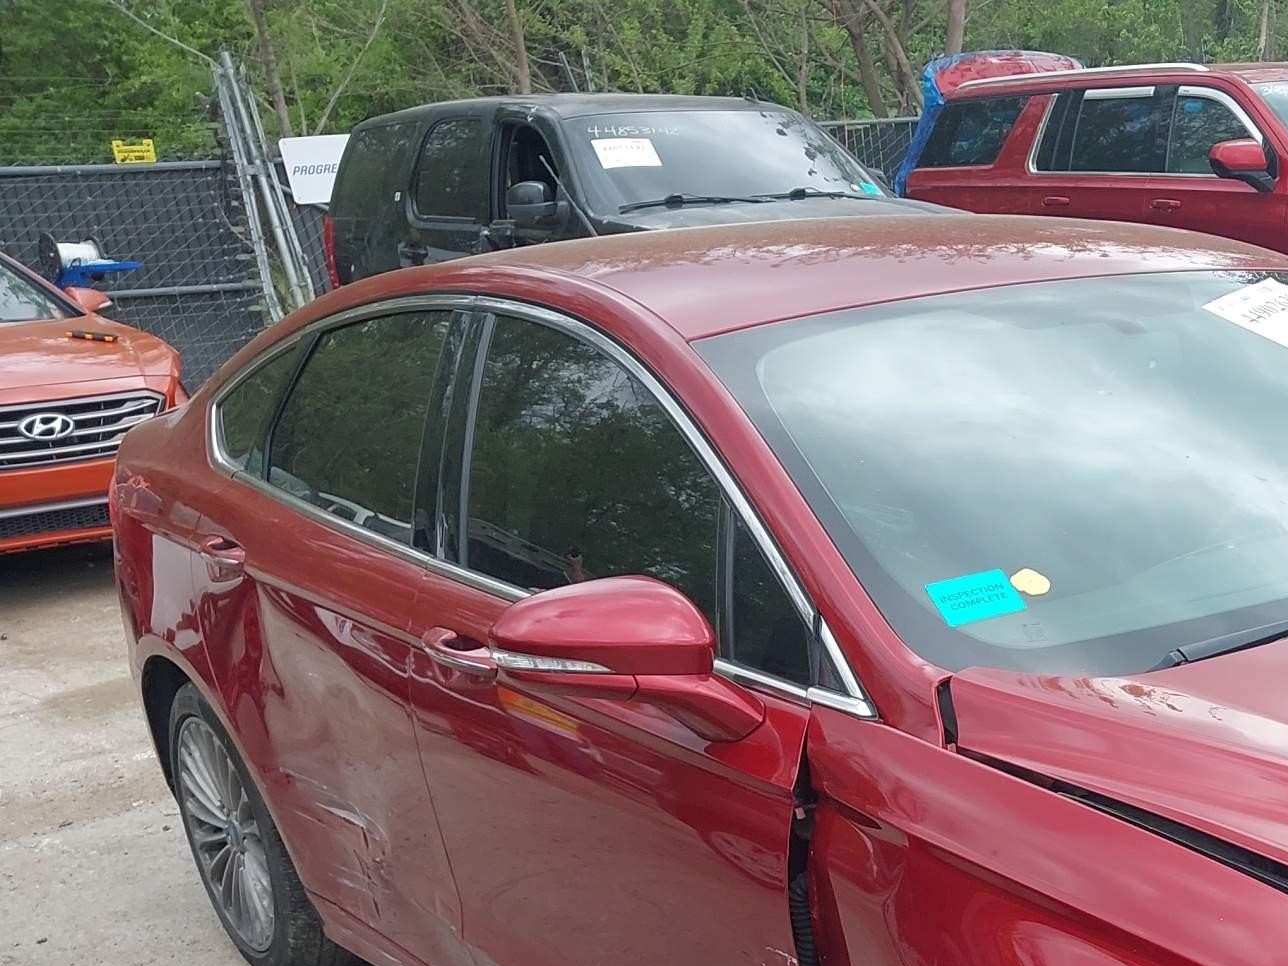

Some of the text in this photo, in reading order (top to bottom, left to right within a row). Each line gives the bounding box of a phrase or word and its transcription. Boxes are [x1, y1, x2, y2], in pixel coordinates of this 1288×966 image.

[293, 163, 338, 176] PROGRE
[939, 583, 1005, 604] INSPECTION
[950, 592, 1009, 611] COMPLETE
